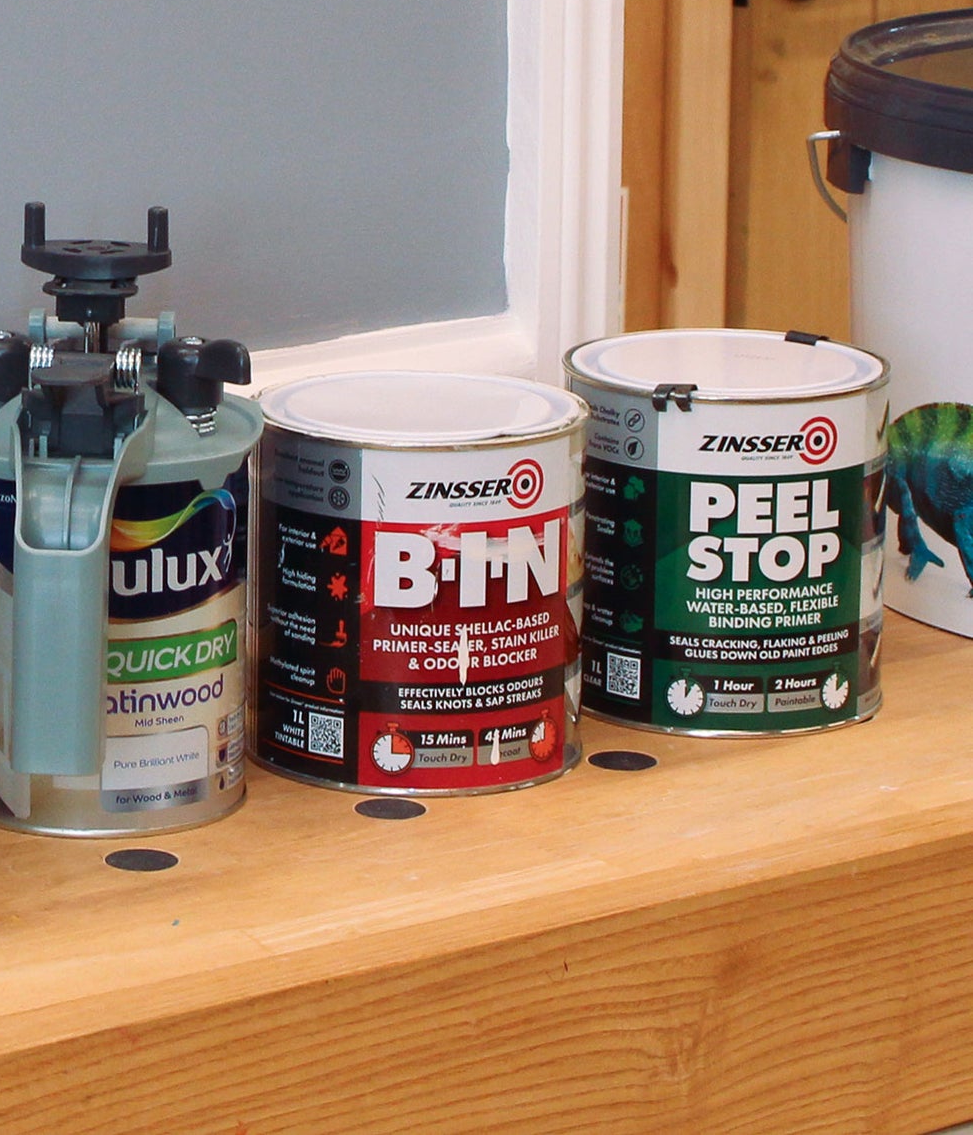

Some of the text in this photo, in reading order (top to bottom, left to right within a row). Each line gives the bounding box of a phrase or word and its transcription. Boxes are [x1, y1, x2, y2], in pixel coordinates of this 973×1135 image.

[698, 434, 804, 452] ZINSSER
[405, 478, 512, 500] ZINSSER
[689, 478, 839, 534] PEEL
[288, 527, 310, 539] interior
[311, 531, 317, 540] &
[282, 535, 317, 549] exterior use
[686, 531, 841, 582] STOP
[111, 546, 223, 596] ulux
[282, 567, 316, 584] High hiding
[282, 576, 316, 592] formulation
[695, 582, 833, 601] HIGH PERFORMANCE
[686, 595, 839, 616] WATER-BASED, FLEXIBLE
[288, 611, 316, 625] adhesion
[708, 613, 821, 629] BINDING PRIMER
[299, 625, 316, 634] need
[390, 624, 451, 637] UNIQUE
[373, 624, 560, 653] PRIMER-SEAER, STAIN KILLER
[669, 629, 849, 650] SEALS CRACKING, FLAKING & PEELING
[107, 629, 235, 677] QUICK DRY
[408, 648, 537, 670] & ODOR BLOCKER
[684, 643, 838, 660] GLUES DOWN OLD PAINT EDGES
[591, 660, 602, 674] 1L
[290, 673, 315, 687] cleanup
[398, 676, 544, 698] EFFECTIVELY BLOCKS ODOURS
[583, 673, 602, 687] CLEAR
[714, 680, 754, 691] 1 Hour
[775, 678, 817, 690] 2 Hours
[107, 673, 223, 714] atinwood
[400, 689, 542, 710] SEALS KNOTS & SAP STREAKS
[775, 695, 816, 706] Paintable
[708, 699, 757, 711] Touch Dry
[134, 715, 184, 728] Mid Sheen
[292, 709, 305, 724] 1L
[283, 723, 305, 737] WHITE
[501, 726, 527, 740] Mins
[275, 731, 305, 749] TINTABLE
[420, 734, 467, 745] 15 Mins
[114, 751, 199, 769] Pure Brilliant White
[419, 753, 467, 764] Touch Dry
[116, 787, 198, 804] for Wood & Metal
